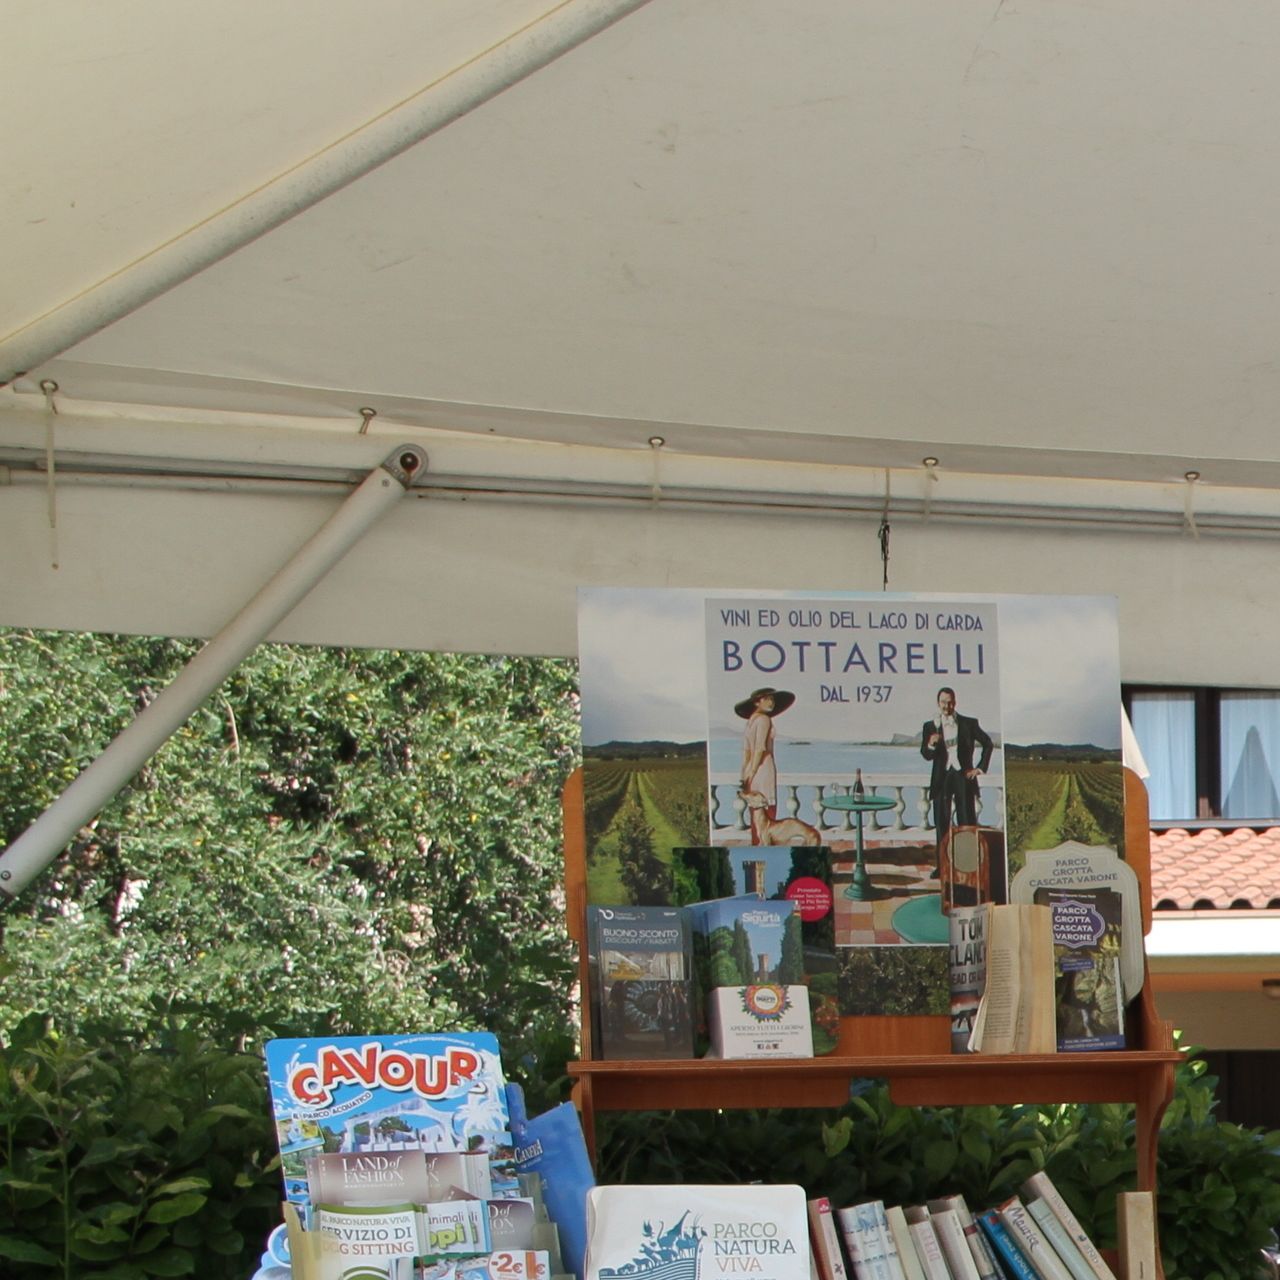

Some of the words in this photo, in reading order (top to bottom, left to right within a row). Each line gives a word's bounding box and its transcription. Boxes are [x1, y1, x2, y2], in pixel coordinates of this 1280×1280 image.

[721, 610, 750, 627] VINI
[759, 610, 779, 627] ED
[789, 611, 822, 628] OLIO
[831, 611, 861, 629] DEL
[915, 612, 929, 630] DI
[722, 639, 985, 675] BOTTARELLI
[820, 685, 850, 703] DAL
[857, 685, 893, 703] 1937
[1055, 858, 1089, 867] PARCO
[1052, 866, 1093, 877] GROTTA
[1029, 876, 1074, 888] CASCATA
[1076, 873, 1119, 883] VARONE
[1057, 907, 1088, 915] PARCO
[1054, 916, 1092, 924] GROTTA
[603, 928, 638, 938] BUONO
[639, 929, 679, 938] SCONTO
[1053, 925, 1094, 933] CASCATA
[1055, 933, 1092, 941] VARONE
[290, 1045, 487, 1105] CAVOUR
[303, 1110, 330, 1119] PARCO
[332, 1092, 371, 1114] ACQUATICO
[342, 1156, 389, 1172] LAND
[389, 1155, 403, 1170] of
[344, 1170, 404, 1184] FASHION
[353, 1218, 389, 1227] NATURA
[389, 1215, 411, 1225] VIVA
[394, 1226, 413, 1240] DI
[713, 1222, 778, 1239] PARCO
[1008, 1206, 1041, 1252] Maurice
[352, 1241, 415, 1256] SITTING
[714, 1239, 797, 1256] NATURA
[715, 1257, 763, 1273] VIVA
